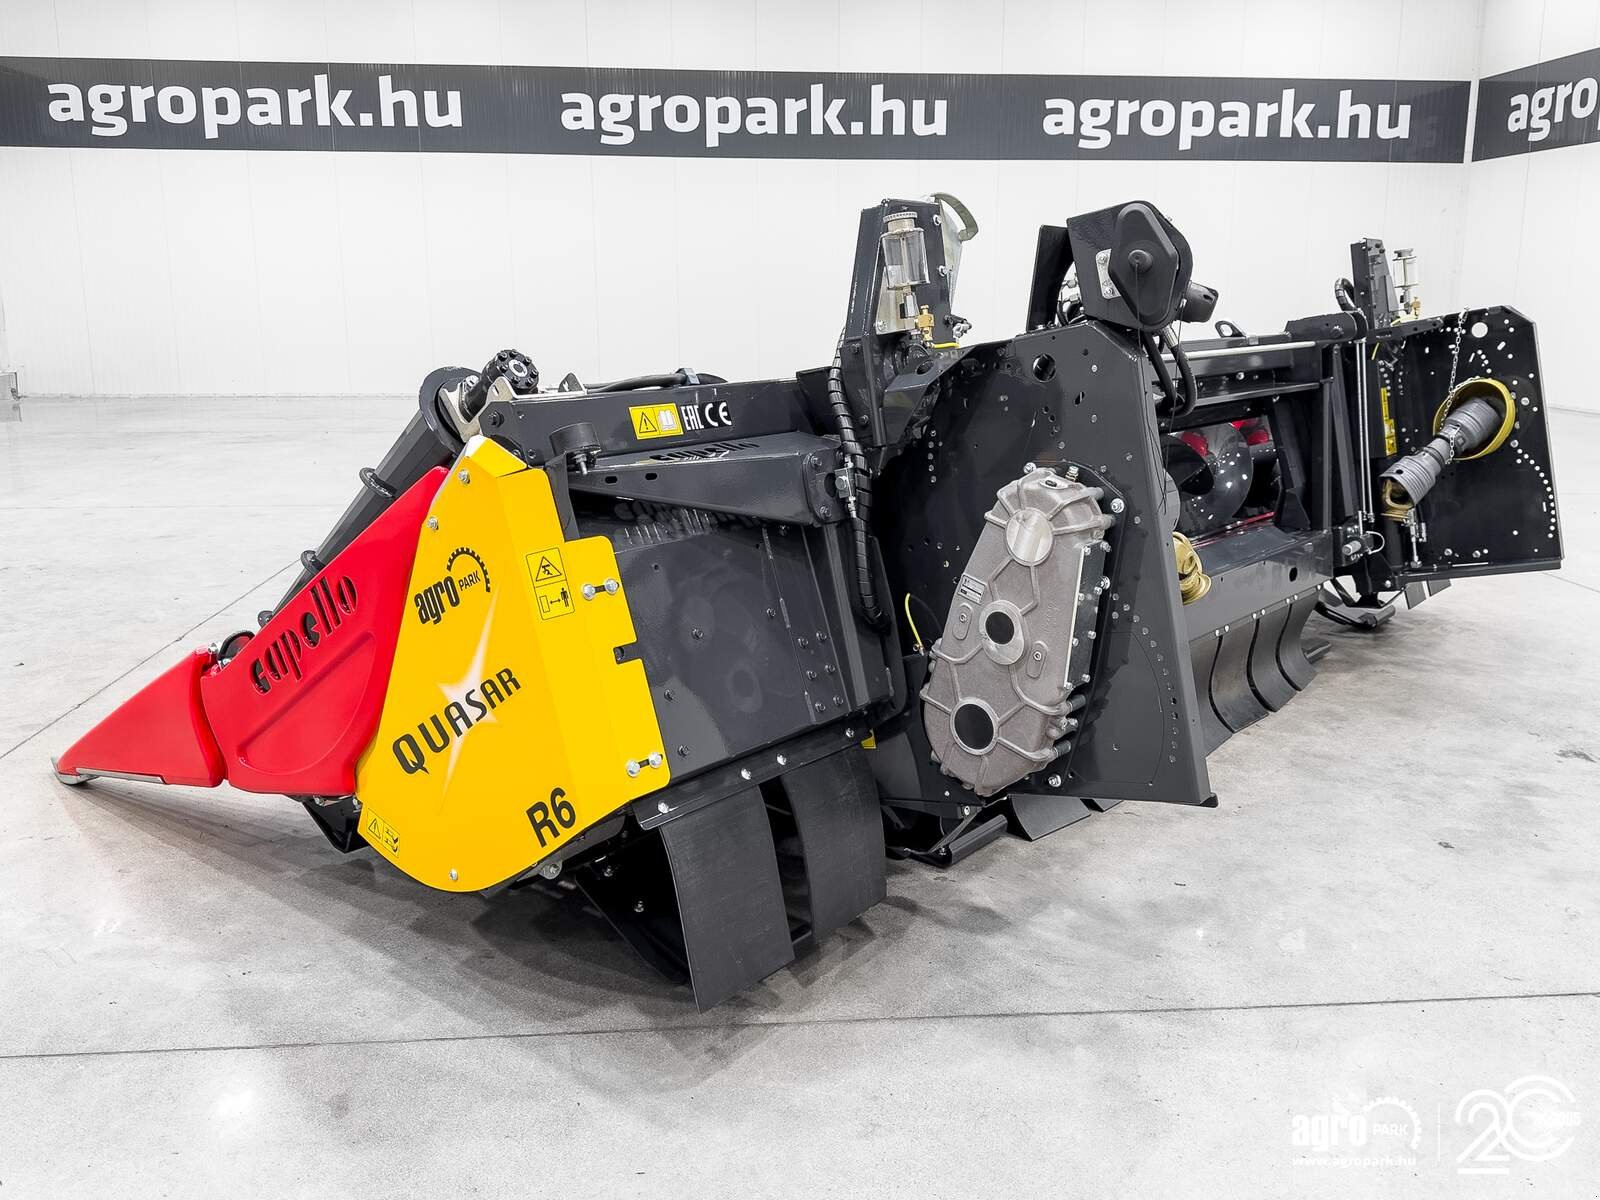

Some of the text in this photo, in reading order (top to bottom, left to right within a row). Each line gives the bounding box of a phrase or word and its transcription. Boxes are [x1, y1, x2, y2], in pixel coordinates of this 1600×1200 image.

[47, 73, 463, 140] agropark.hu
[560, 83, 948, 148] agropark.hu
[1042, 88, 1411, 151] agropark.hu
[1507, 77, 1600, 142] agro
[414, 570, 481, 625] agro PARK
[392, 666, 522, 775] QUASAR
[525, 786, 577, 848] R6
